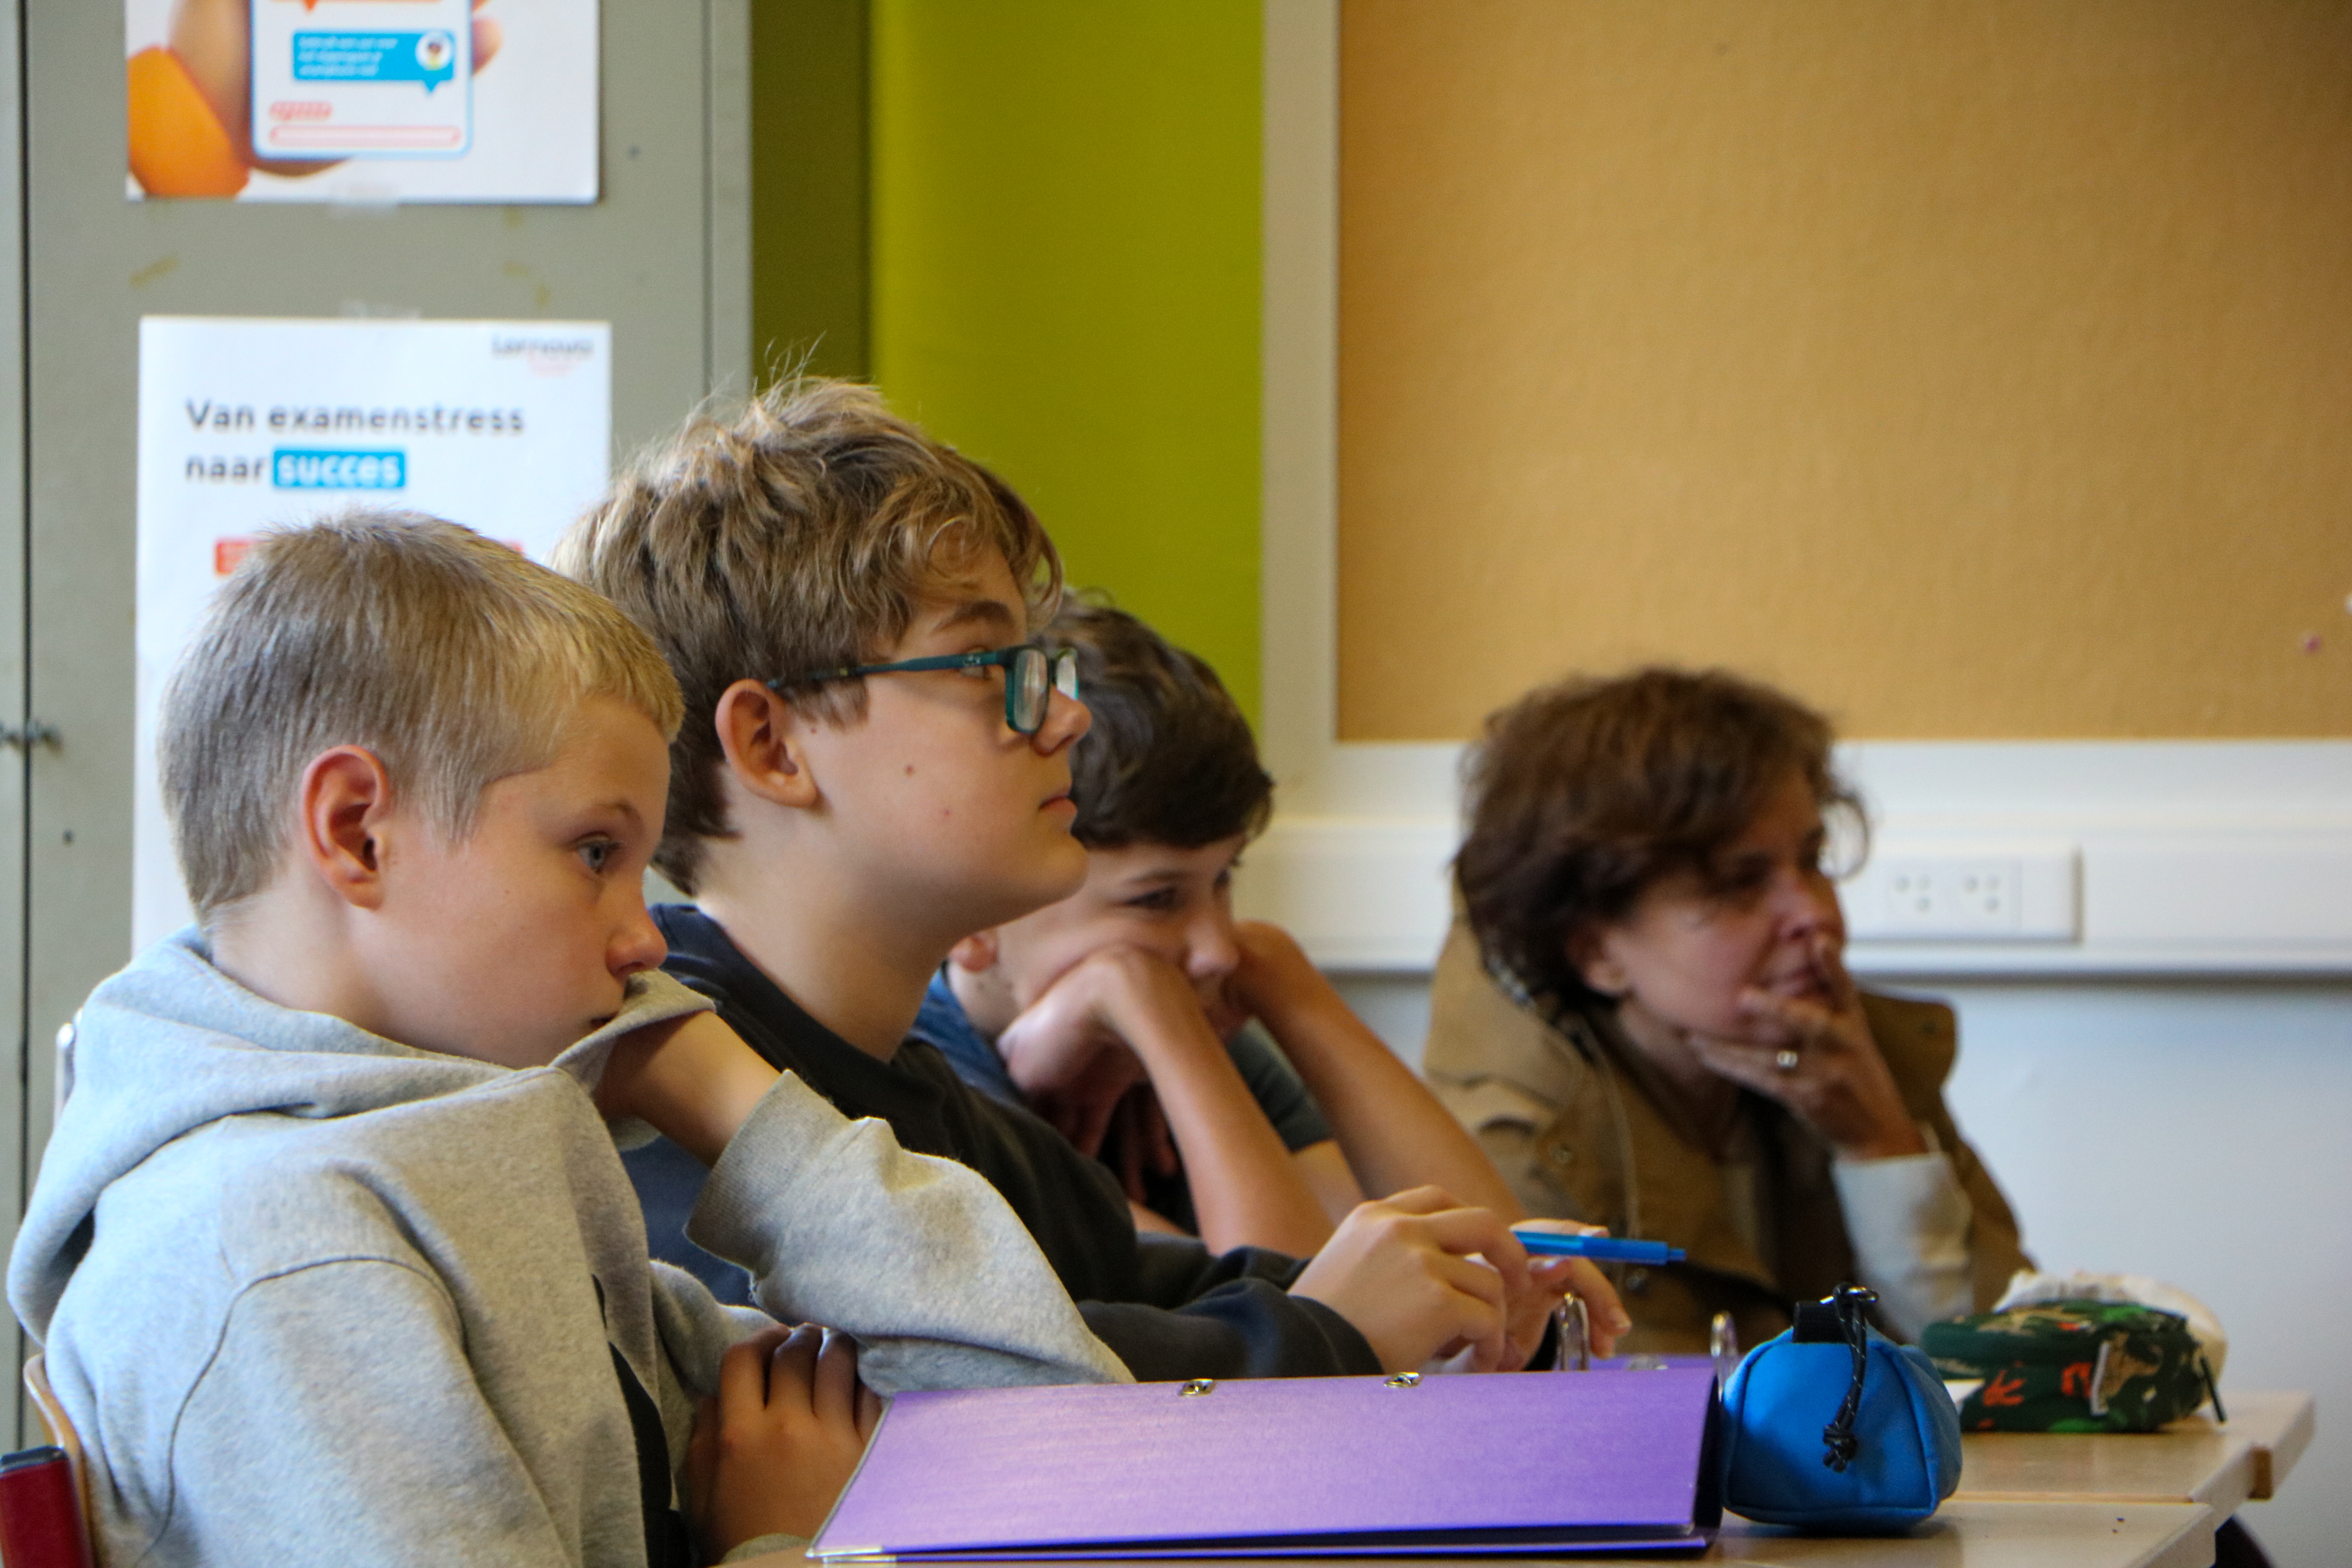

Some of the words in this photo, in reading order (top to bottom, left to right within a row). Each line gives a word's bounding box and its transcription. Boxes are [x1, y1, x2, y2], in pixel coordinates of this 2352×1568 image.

[185, 399, 255, 430] Van
[267, 403, 523, 432] examenstress
[185, 455, 264, 481] naar
[278, 456, 399, 484] succes
